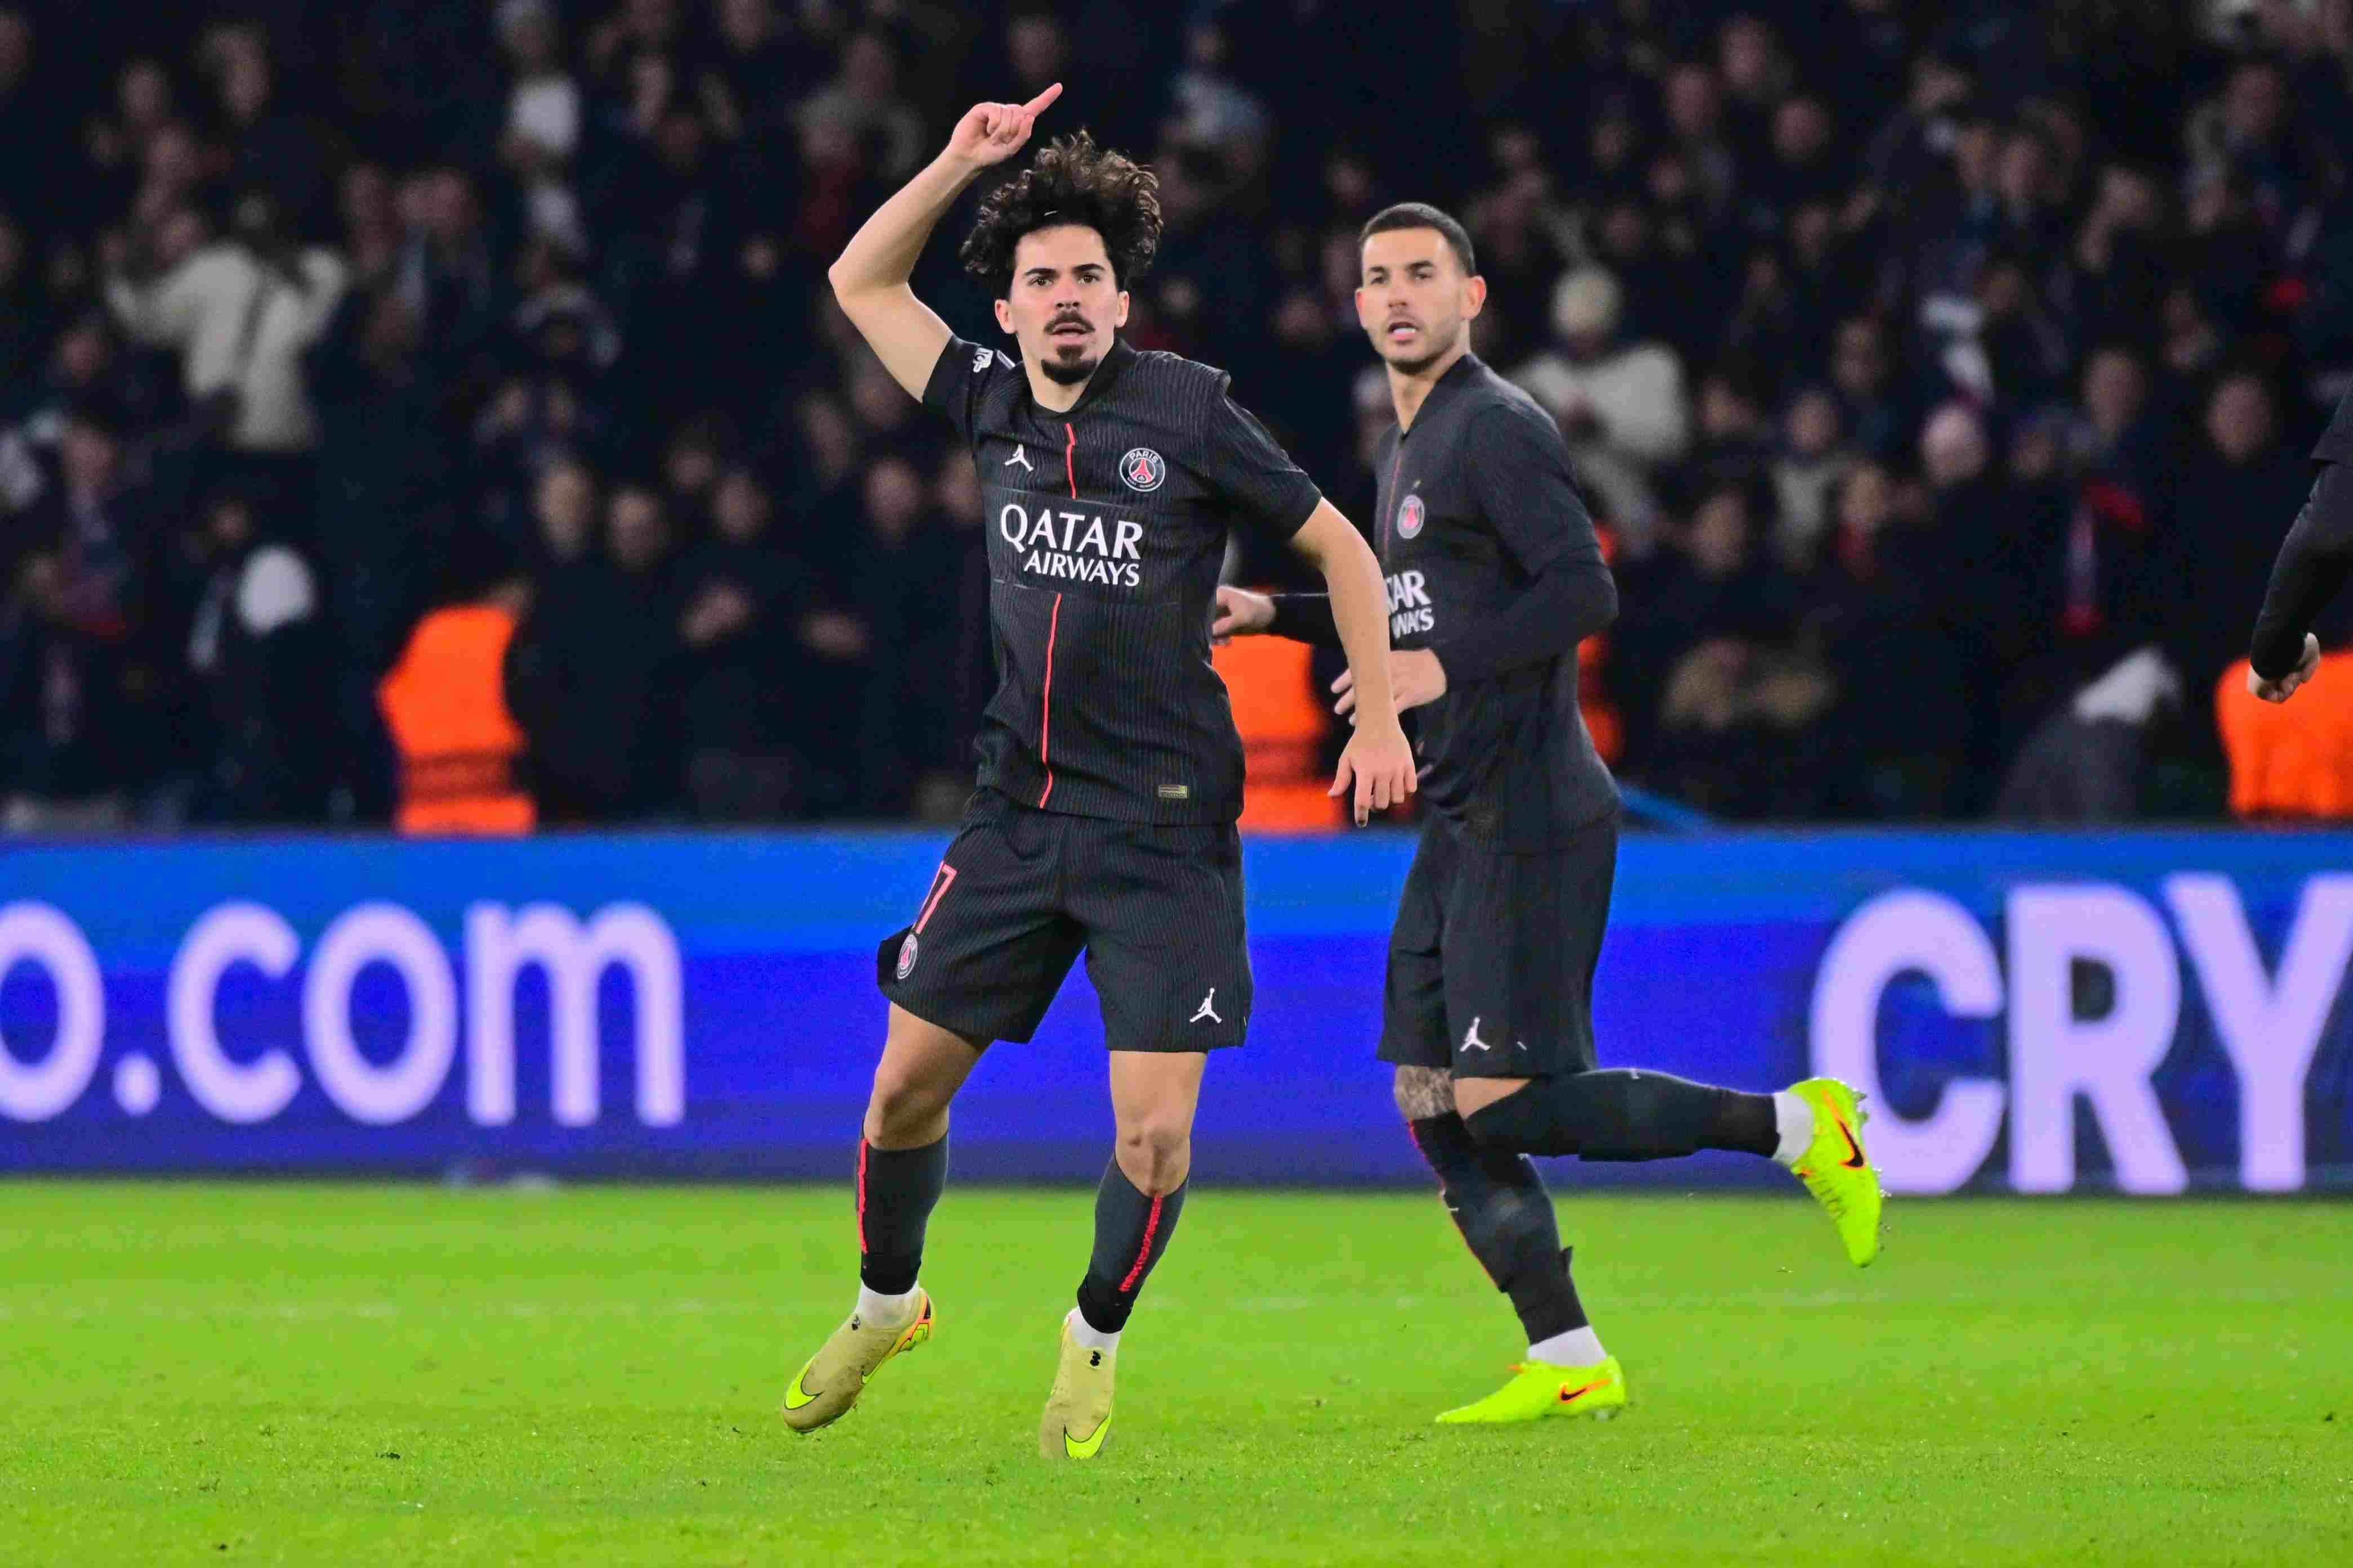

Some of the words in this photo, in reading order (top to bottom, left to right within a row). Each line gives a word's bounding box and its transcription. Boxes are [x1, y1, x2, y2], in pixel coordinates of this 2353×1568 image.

[1128, 450, 1159, 463] PARIS
[1000, 504, 1143, 560] QATAR
[1023, 550, 1140, 587] AIRWAYS
[0, 900, 685, 1126] o.com
[1809, 872, 2353, 1196] CRY
